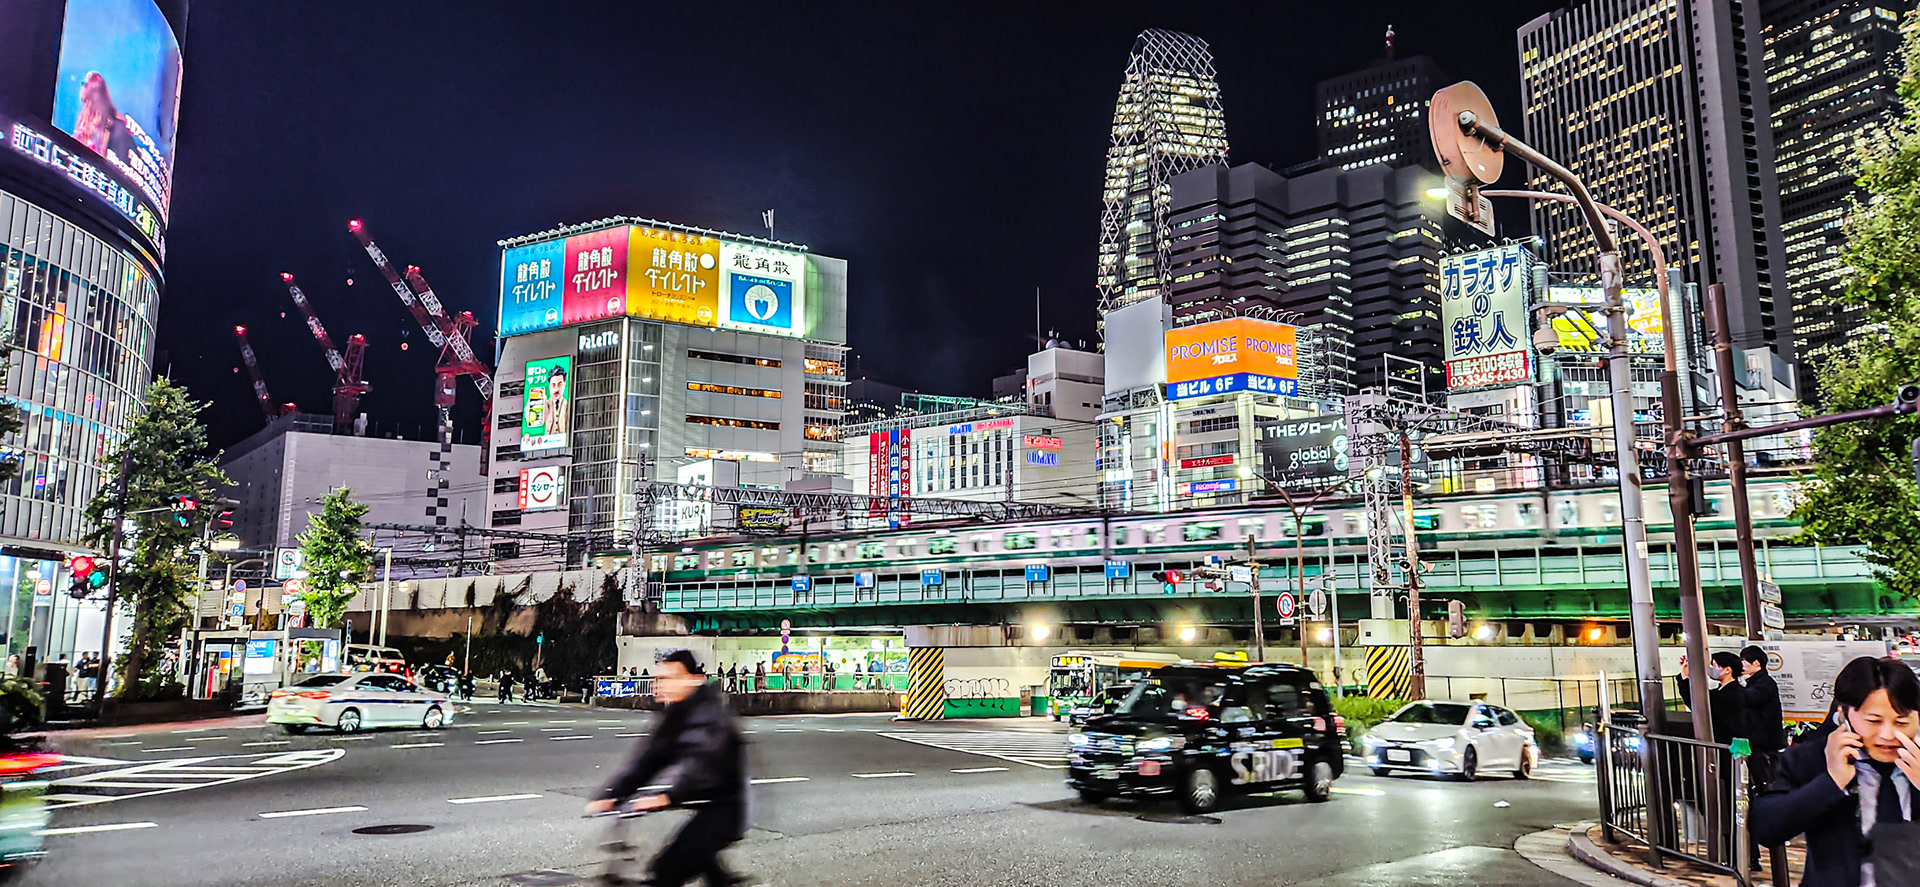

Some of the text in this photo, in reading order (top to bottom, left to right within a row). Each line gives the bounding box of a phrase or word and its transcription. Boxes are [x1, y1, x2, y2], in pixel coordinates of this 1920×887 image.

[577, 246, 613, 271] 龍角散
[652, 247, 698, 273] 龍角散
[733, 253, 790, 275] 龍角散
[517, 259, 551, 283] 龍角散
[1443, 248, 1519, 300] カラオケ
[1472, 292, 1491, 318] の
[1451, 311, 1517, 356] 鉄人
[1171, 336, 1237, 361] PROMISE
[1246, 337, 1293, 357] PROMISE
[1211, 353, 1238, 366] プロミス
[1176, 377, 1234, 397] 当ビル 6F
[1247, 375, 1295, 394] 当ビル 6F
[1290, 446, 1331, 470] global
[530, 483, 555, 492] スシロー
